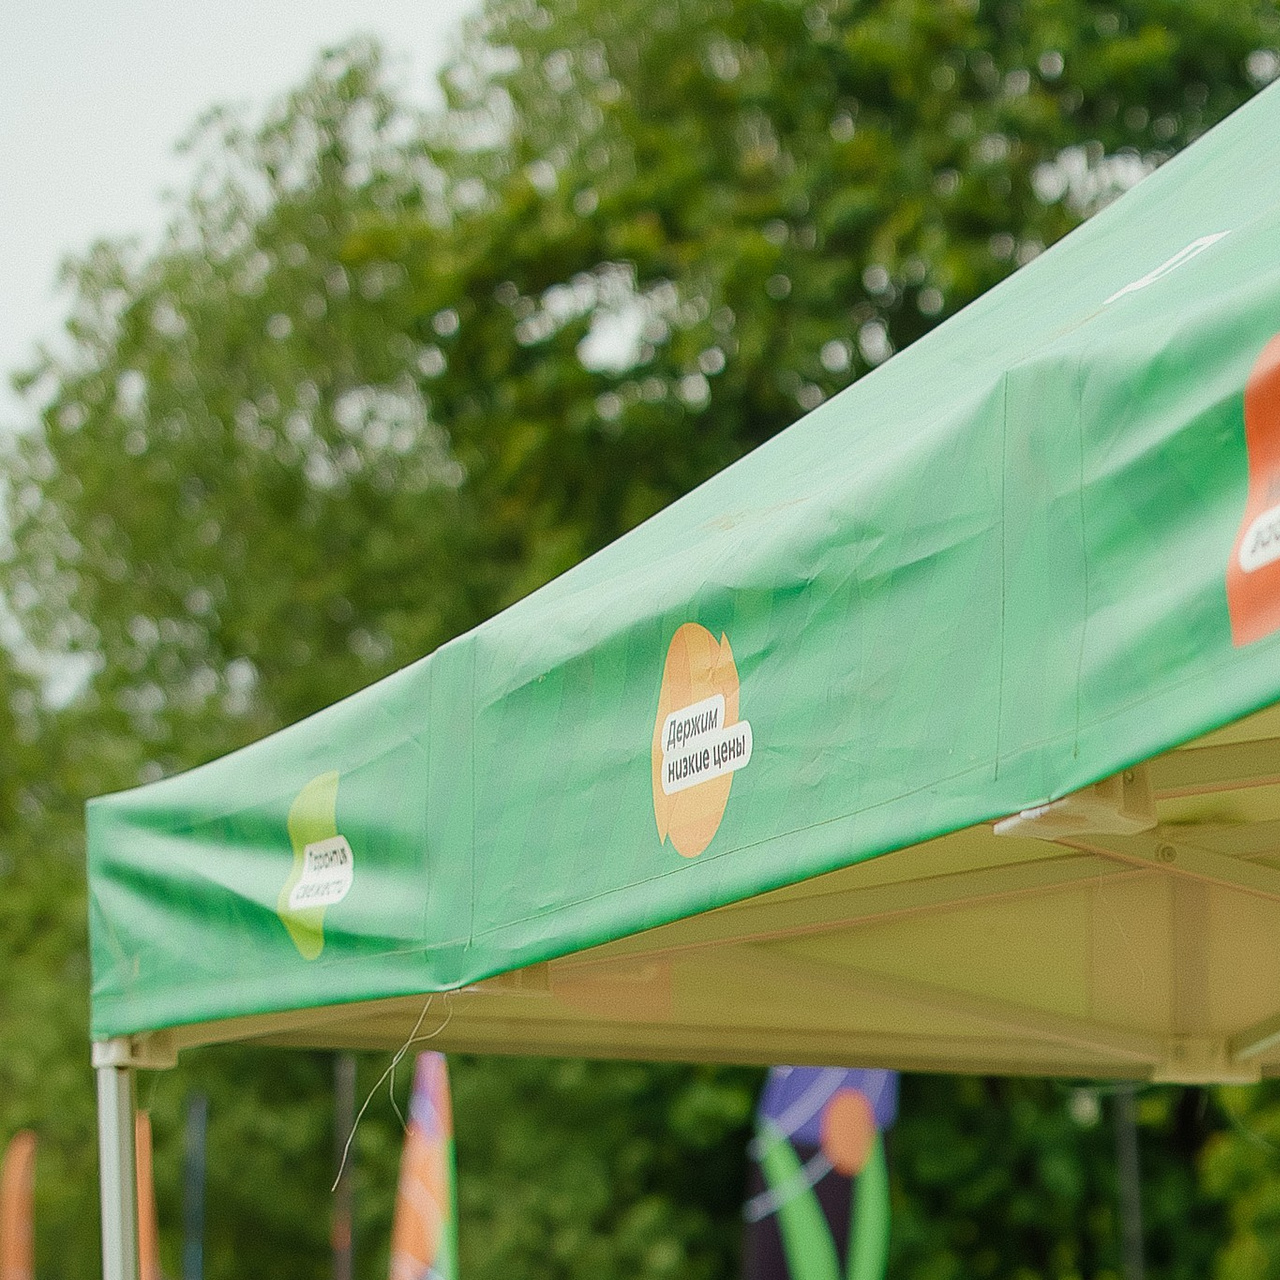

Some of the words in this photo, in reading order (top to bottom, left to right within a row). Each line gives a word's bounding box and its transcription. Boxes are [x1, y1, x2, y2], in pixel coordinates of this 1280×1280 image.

[667, 708, 718, 751] Держим
[668, 749, 710, 783] низкие
[713, 735, 745, 769] цены
